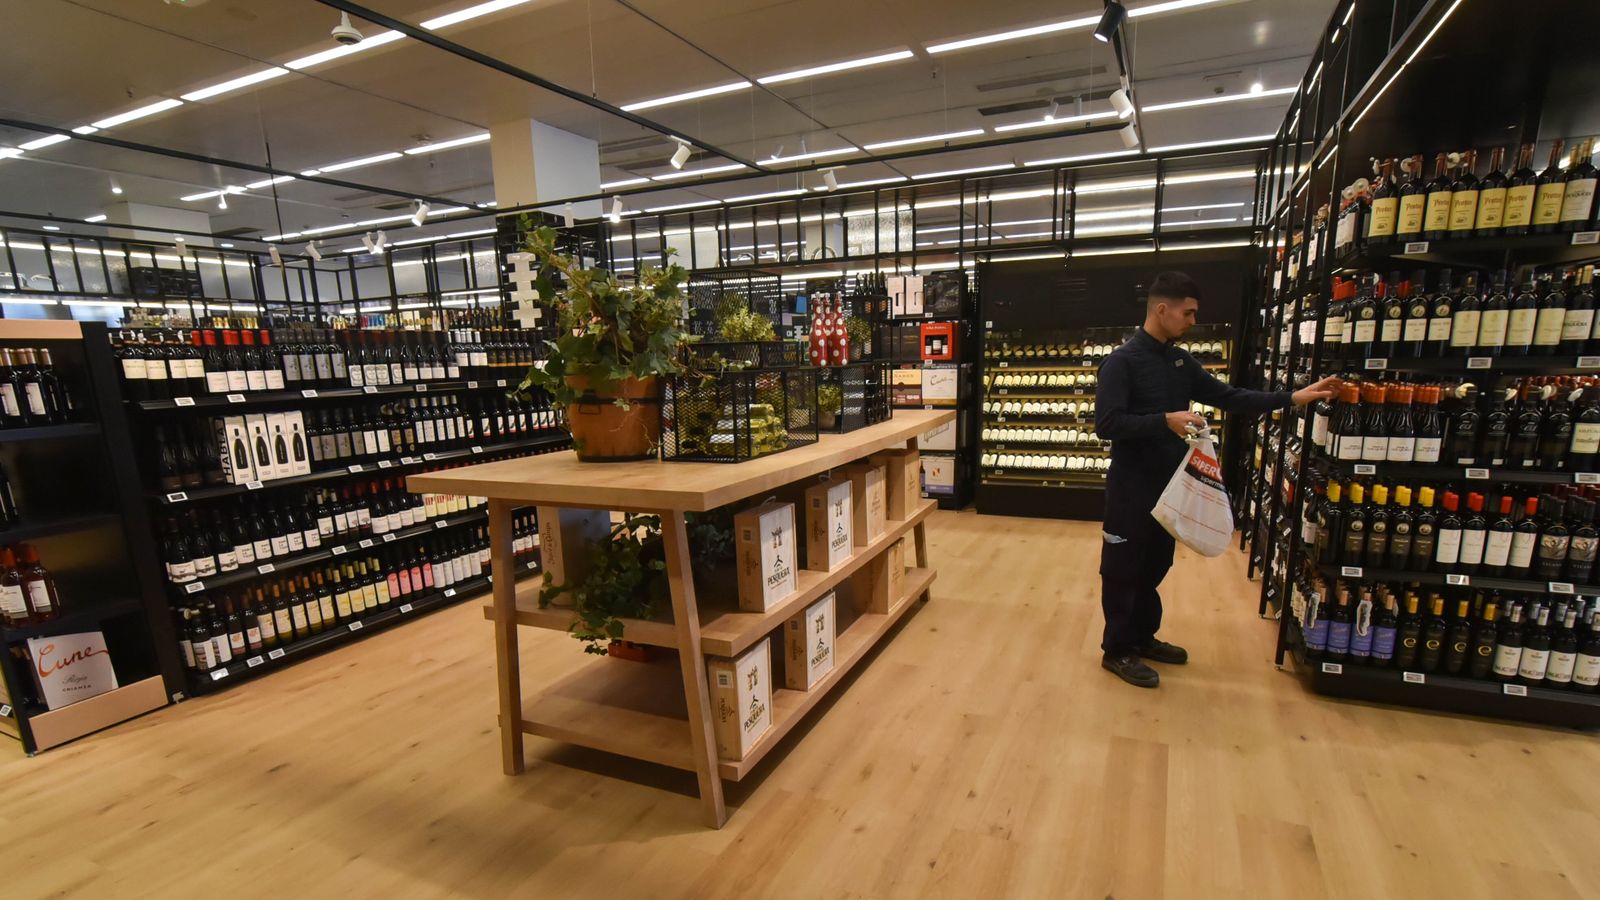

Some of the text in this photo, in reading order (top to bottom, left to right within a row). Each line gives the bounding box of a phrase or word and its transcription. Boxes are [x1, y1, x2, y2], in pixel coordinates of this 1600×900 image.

[217, 427, 232, 477] HABLA
[767, 566, 790, 586] PESQUERA
[38, 643, 109, 678] Cune
